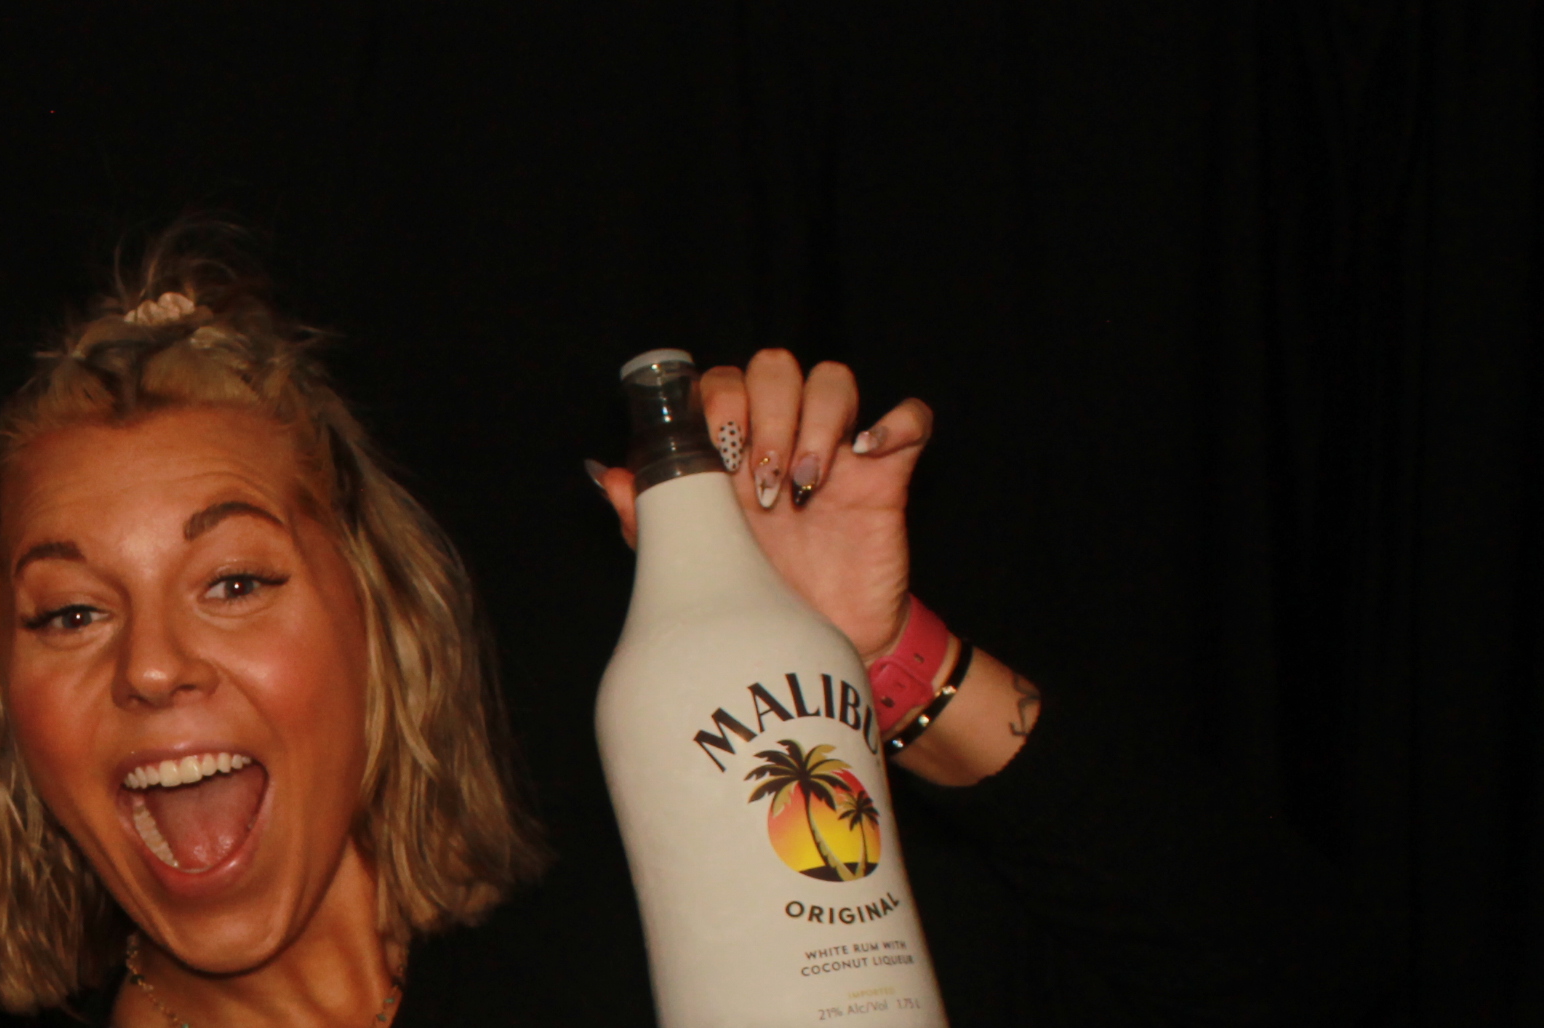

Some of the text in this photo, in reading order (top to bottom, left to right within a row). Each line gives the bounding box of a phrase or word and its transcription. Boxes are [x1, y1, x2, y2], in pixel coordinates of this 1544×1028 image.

[693, 673, 878, 773] MALIBU
[785, 892, 899, 924] ORIGINAL
[805, 940, 907, 961] WHITE RUM WITH
[801, 954, 914, 977] COCONUT LIQUEUR
[818, 1007, 843, 1021] 21%
